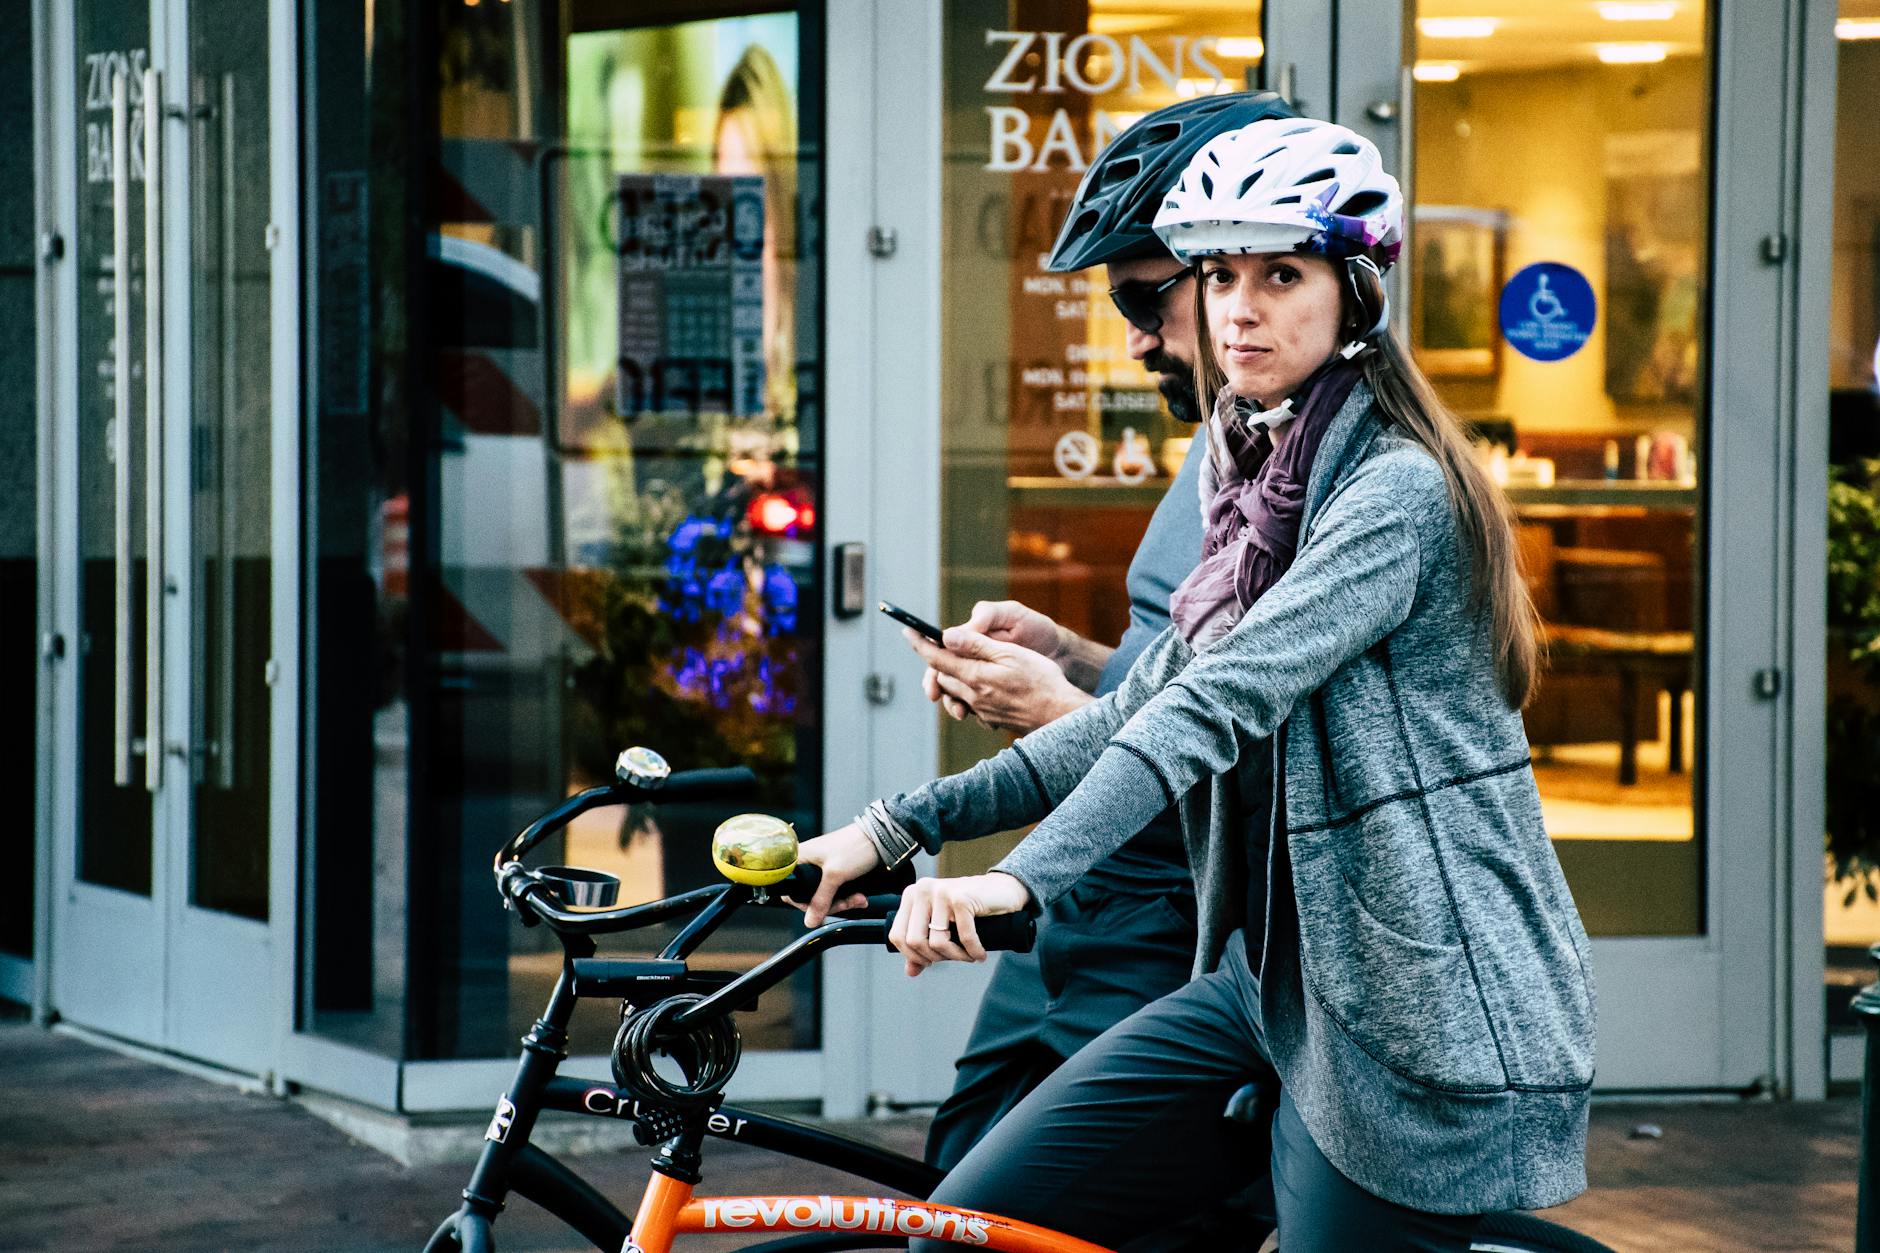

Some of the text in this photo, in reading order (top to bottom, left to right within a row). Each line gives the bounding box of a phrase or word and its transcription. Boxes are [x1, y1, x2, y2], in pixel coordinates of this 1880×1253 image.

[984, 29, 1223, 94] ZIONS
[87, 108, 147, 182] BAK
[985, 105, 1124, 172] BA
[703, 1195, 989, 1245] revolutions
